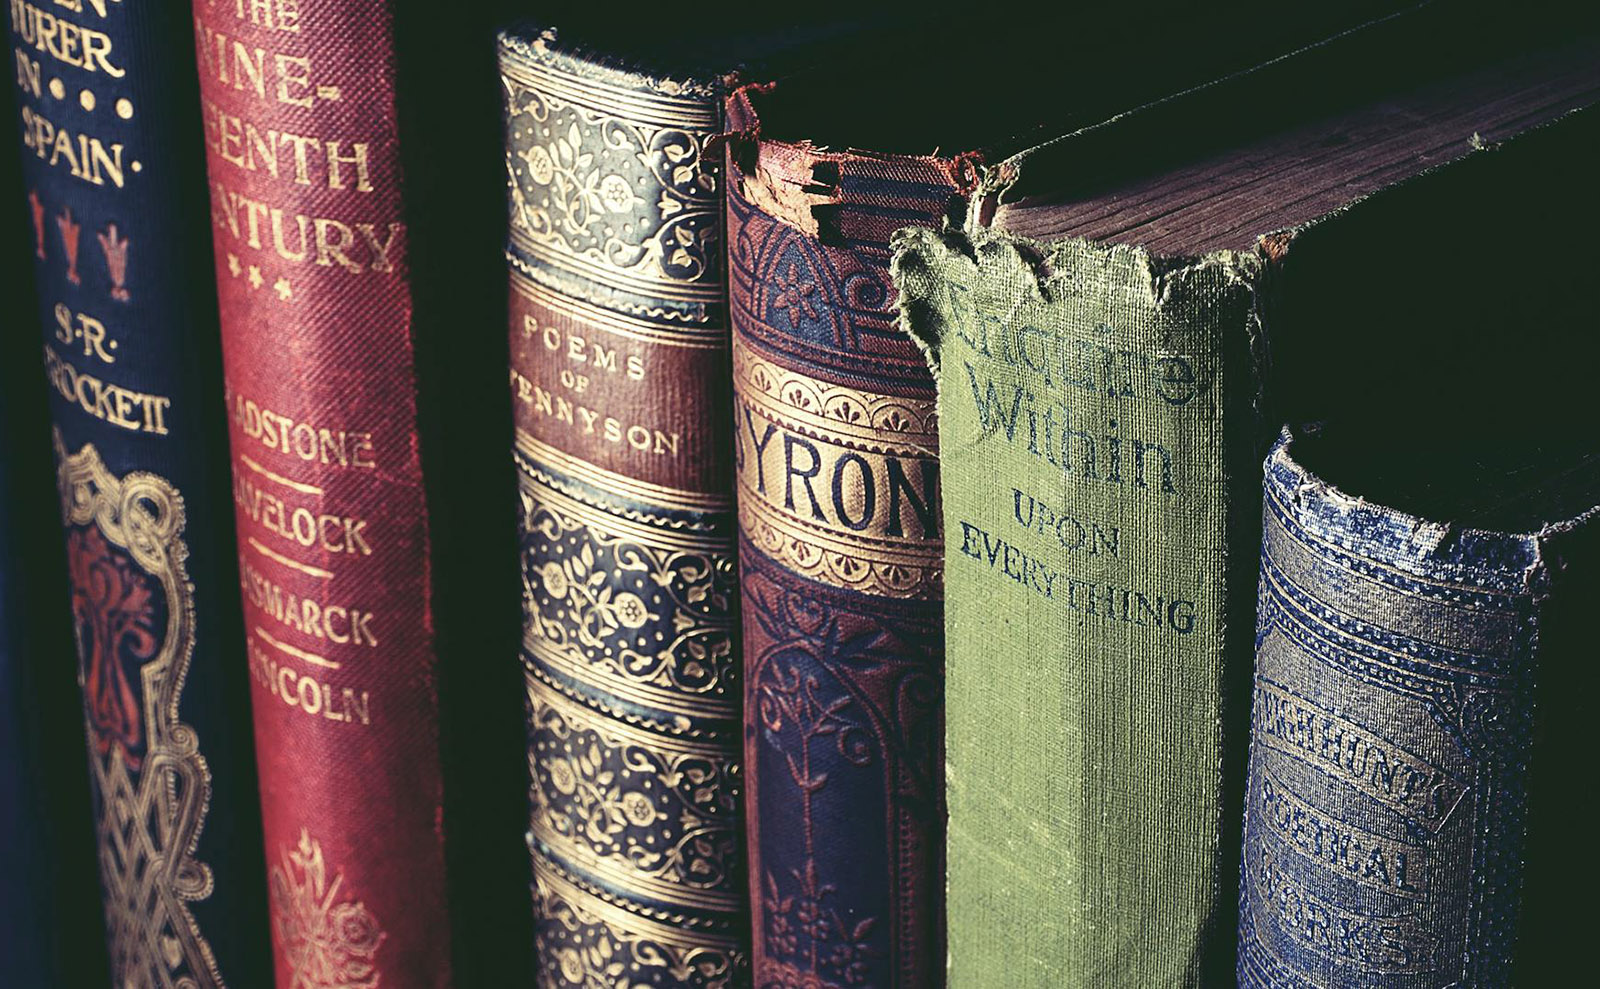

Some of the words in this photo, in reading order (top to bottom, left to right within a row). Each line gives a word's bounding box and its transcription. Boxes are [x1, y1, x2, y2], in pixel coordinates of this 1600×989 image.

[523, 314, 646, 381] POEMS
[561, 370, 590, 393] OF
[963, 360, 1184, 498] Within
[1011, 488, 1121, 558] UPON
